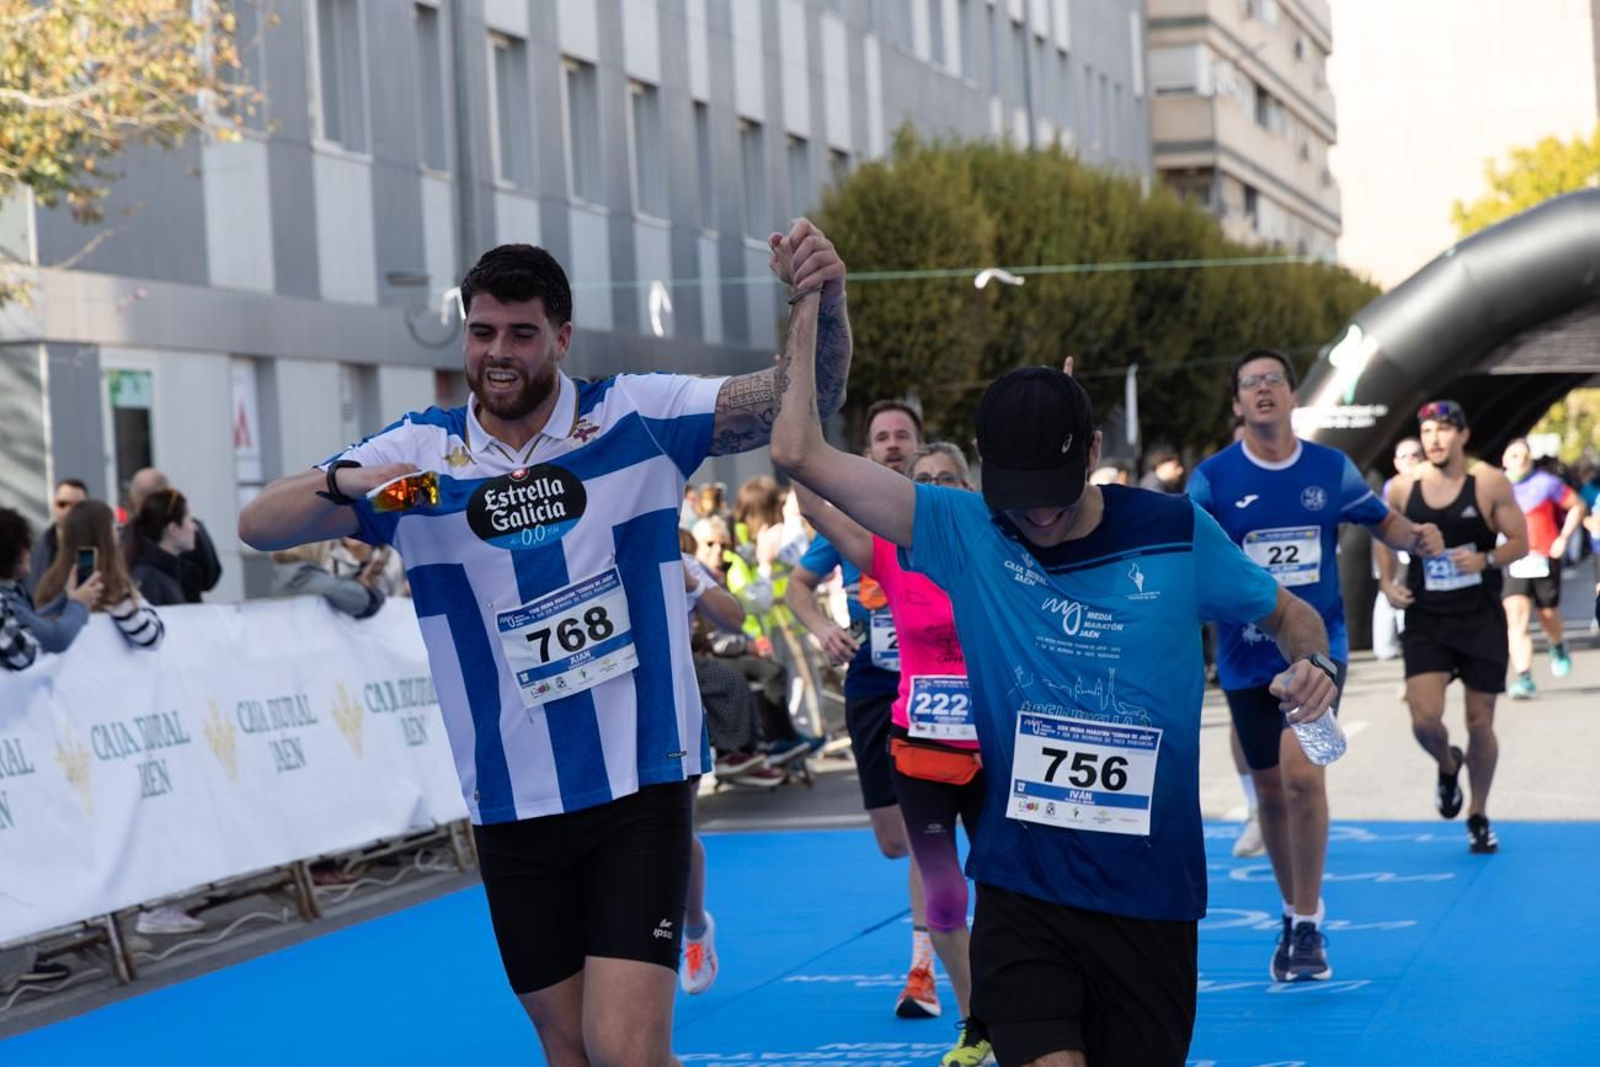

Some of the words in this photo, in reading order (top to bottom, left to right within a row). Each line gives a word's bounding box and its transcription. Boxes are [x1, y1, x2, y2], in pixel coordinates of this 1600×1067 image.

[485, 477, 565, 511] Estrella
[491, 500, 566, 531] Galicia
[521, 524, 546, 546] 0,0
[1268, 545, 1299, 565] 22
[1086, 612, 1113, 622] MEDIA
[525, 606, 614, 664] 768
[1078, 629, 1101, 639] JAÉN
[570, 650, 592, 666] JUAN
[914, 692, 972, 717] 222
[90, 721, 141, 761] CAJA
[1041, 747, 1128, 791] 756
[1069, 789, 1093, 801] IVÁN
